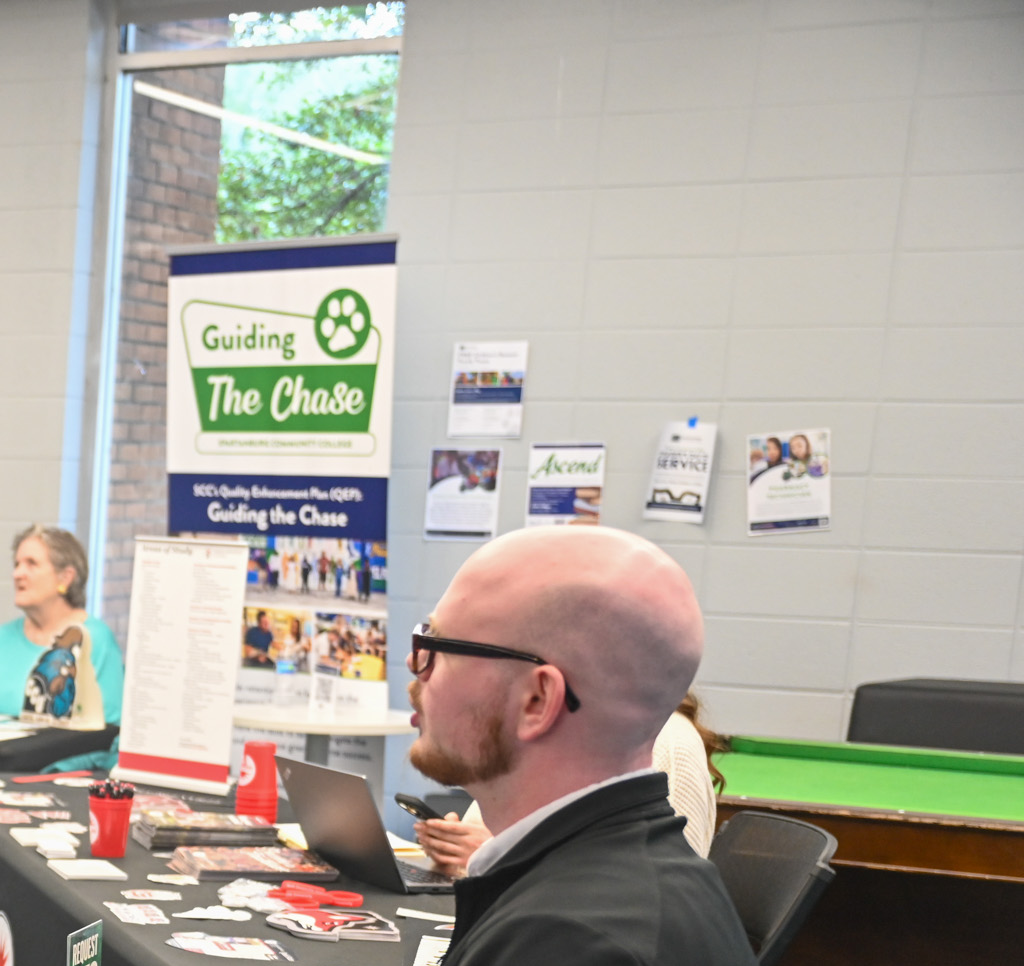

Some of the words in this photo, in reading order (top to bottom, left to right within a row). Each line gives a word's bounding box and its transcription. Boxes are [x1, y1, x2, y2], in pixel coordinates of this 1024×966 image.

[202, 323, 296, 360] Guiding
[206, 375, 263, 421] The
[270, 374, 366, 421] Chase
[530, 452, 603, 479] Ascend
[219, 484, 250, 501] Quality
[251, 485, 309, 500] Enhancement
[310, 486, 329, 500] Plan
[207, 501, 269, 531] Guiding
[270, 504, 297, 525] the
[299, 504, 348, 527] Chase
[72, 933, 99, 966] REQUEST
